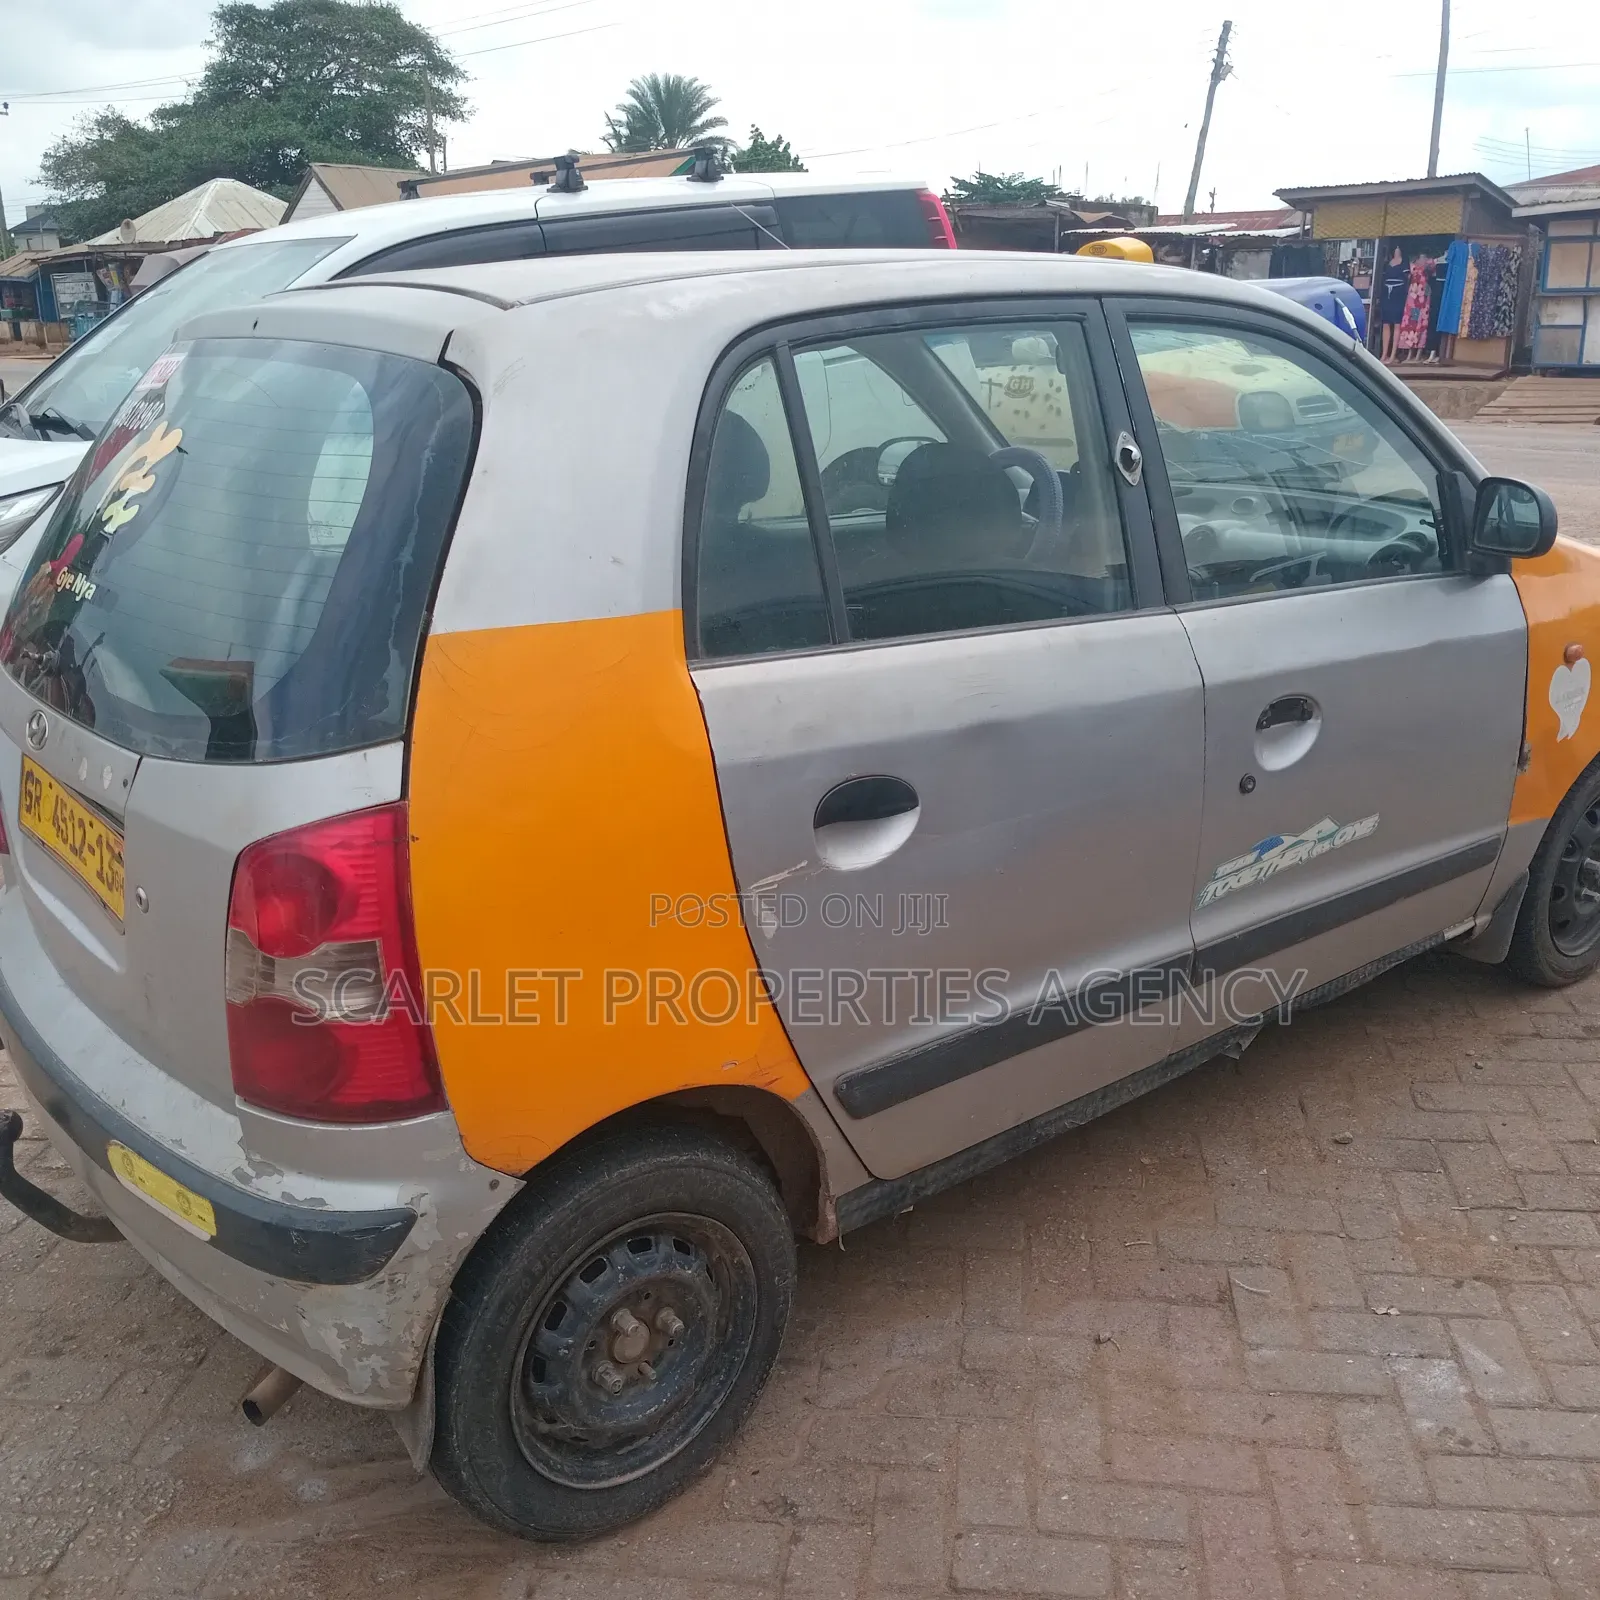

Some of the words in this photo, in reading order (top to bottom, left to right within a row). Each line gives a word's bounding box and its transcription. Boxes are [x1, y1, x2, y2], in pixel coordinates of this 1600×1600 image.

[56, 566, 75, 593] Gye
[71, 572, 97, 602] Nya
[24, 768, 42, 823] GR
